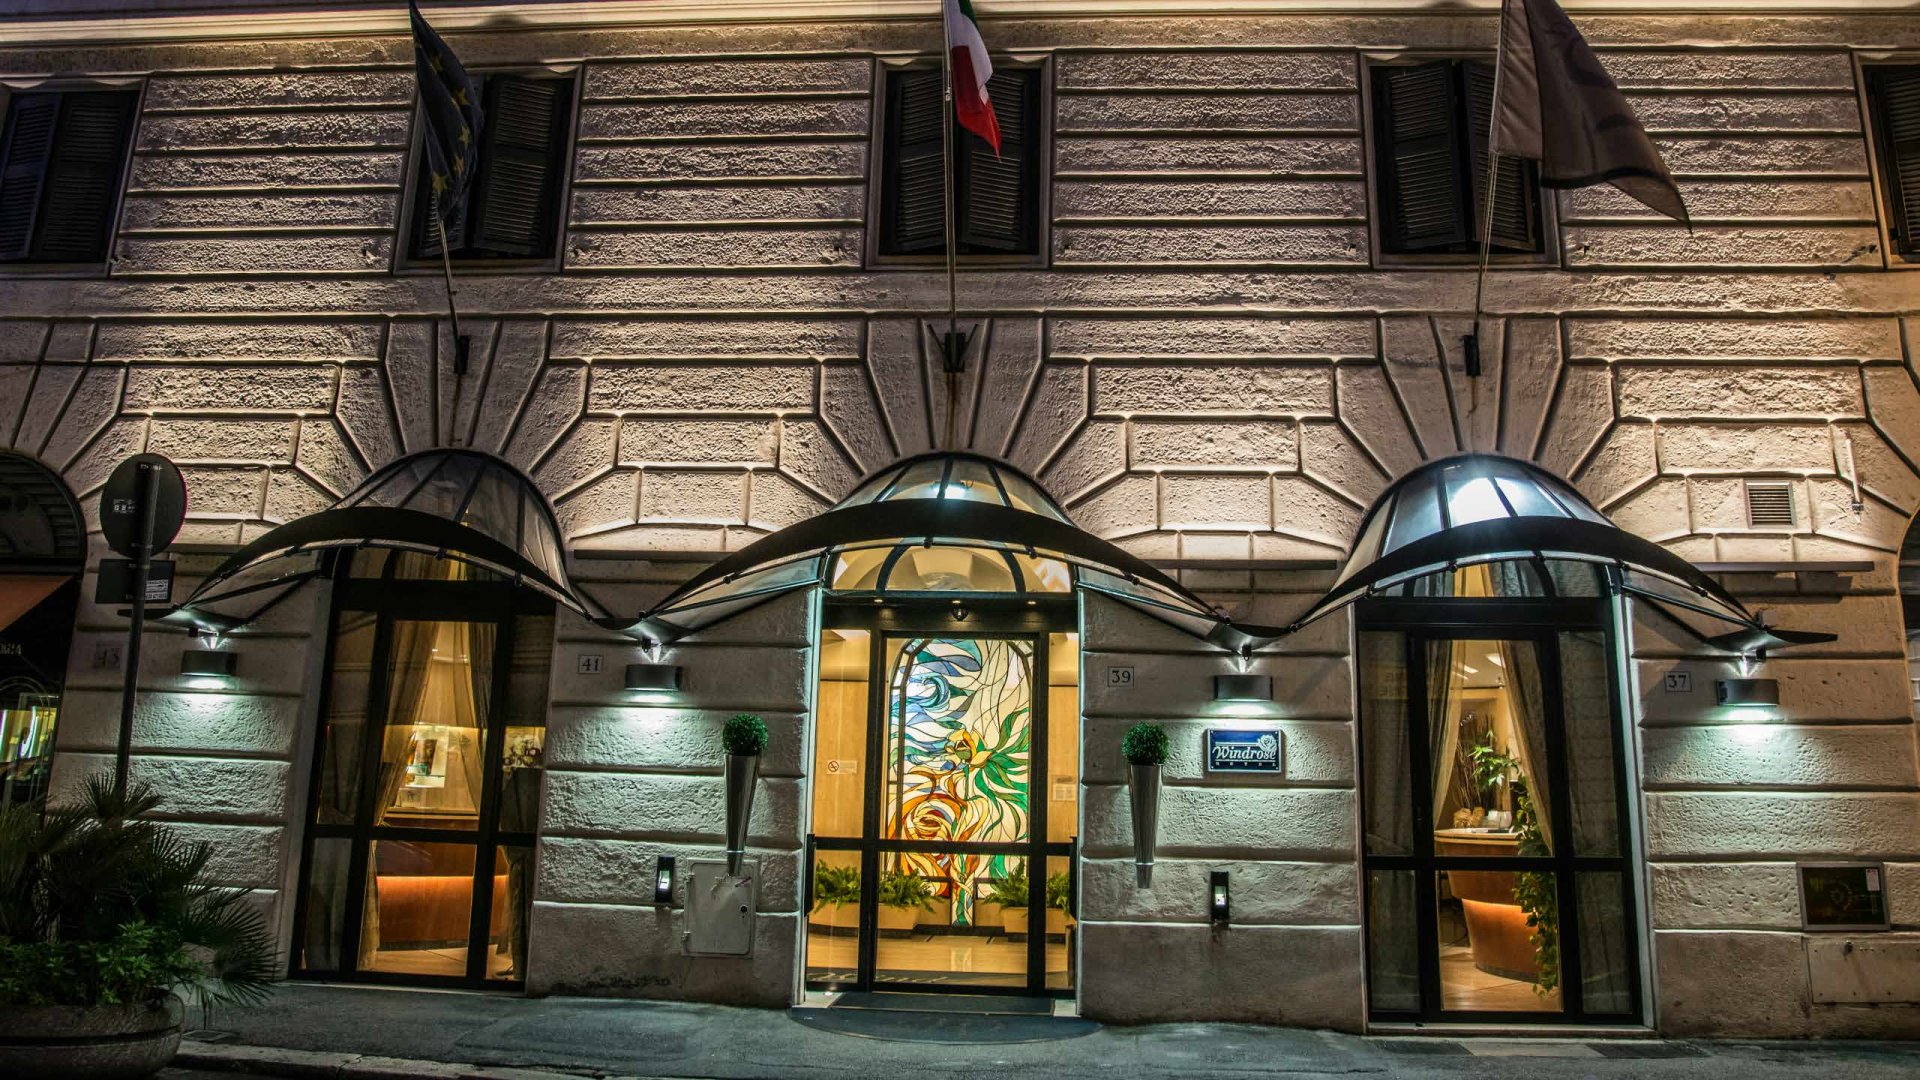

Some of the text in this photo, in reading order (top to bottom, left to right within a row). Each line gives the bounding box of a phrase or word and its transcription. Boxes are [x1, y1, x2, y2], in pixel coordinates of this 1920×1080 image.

[582, 657, 600, 672] 41
[1111, 669, 1131, 684] 39
[1667, 674, 1687, 689] 37
[1211, 746, 1277, 760] Windrose
